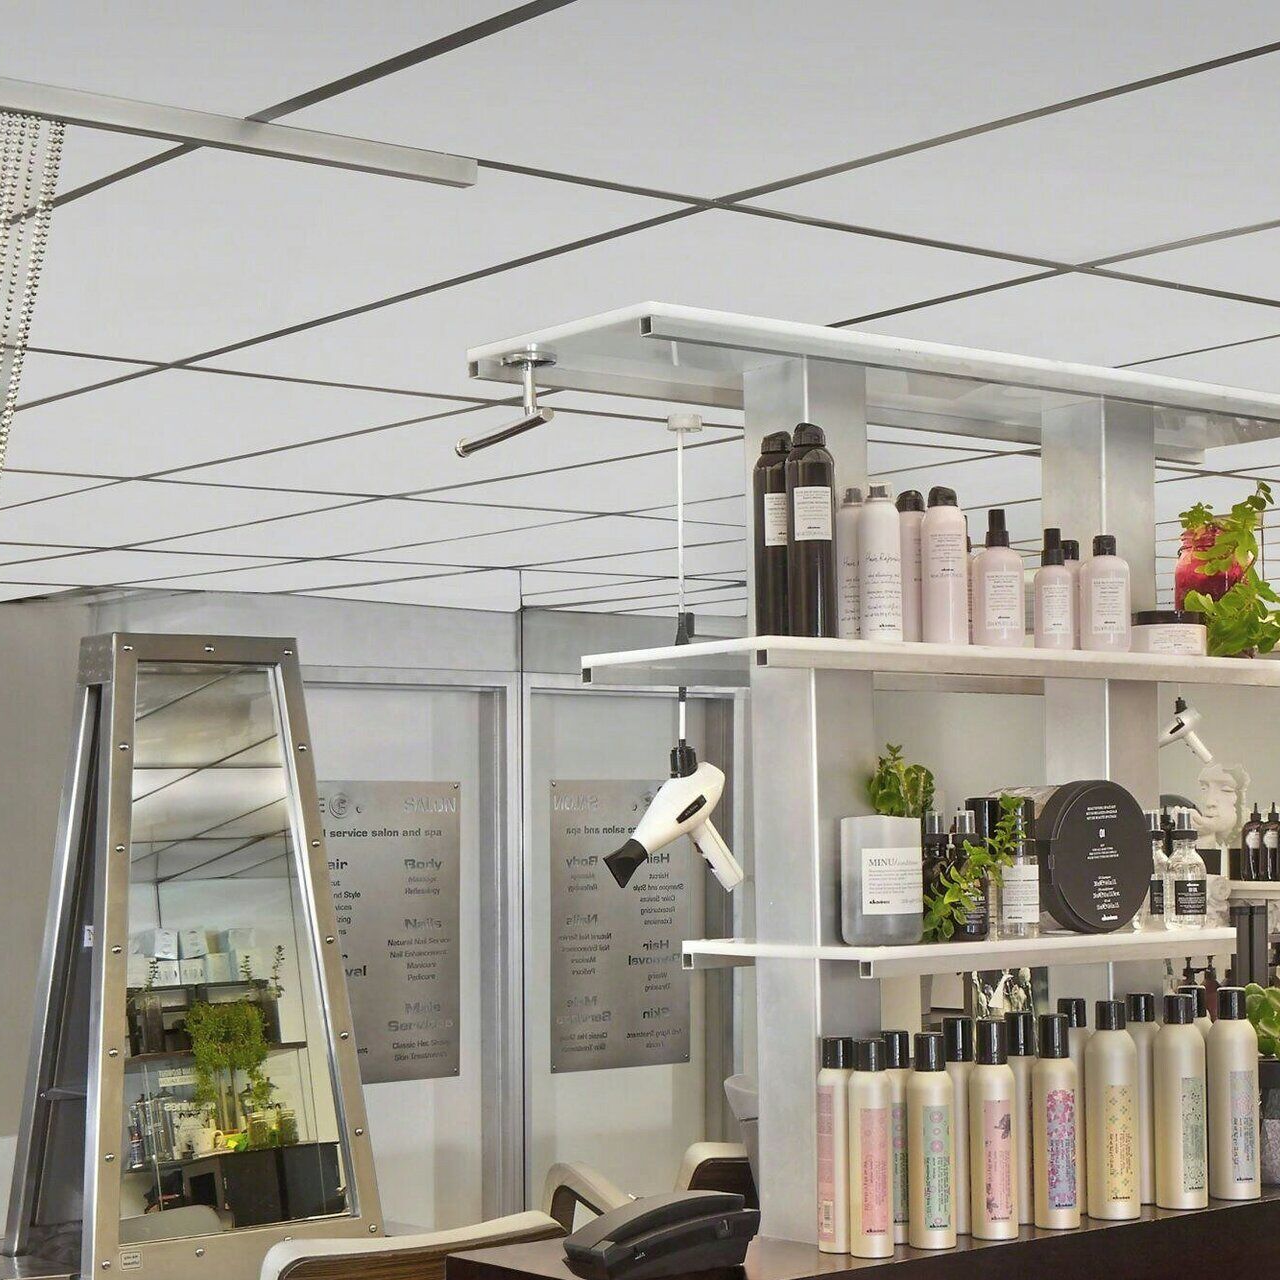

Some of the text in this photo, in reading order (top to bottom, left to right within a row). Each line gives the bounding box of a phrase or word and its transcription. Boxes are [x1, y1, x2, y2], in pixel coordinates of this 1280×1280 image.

[330, 828, 368, 838] service
[372, 828, 398, 837] salon
[402, 828, 420, 837] and
[424, 830, 442, 839] spa
[328, 859, 348, 870] air
[344, 891, 361, 899] Style
